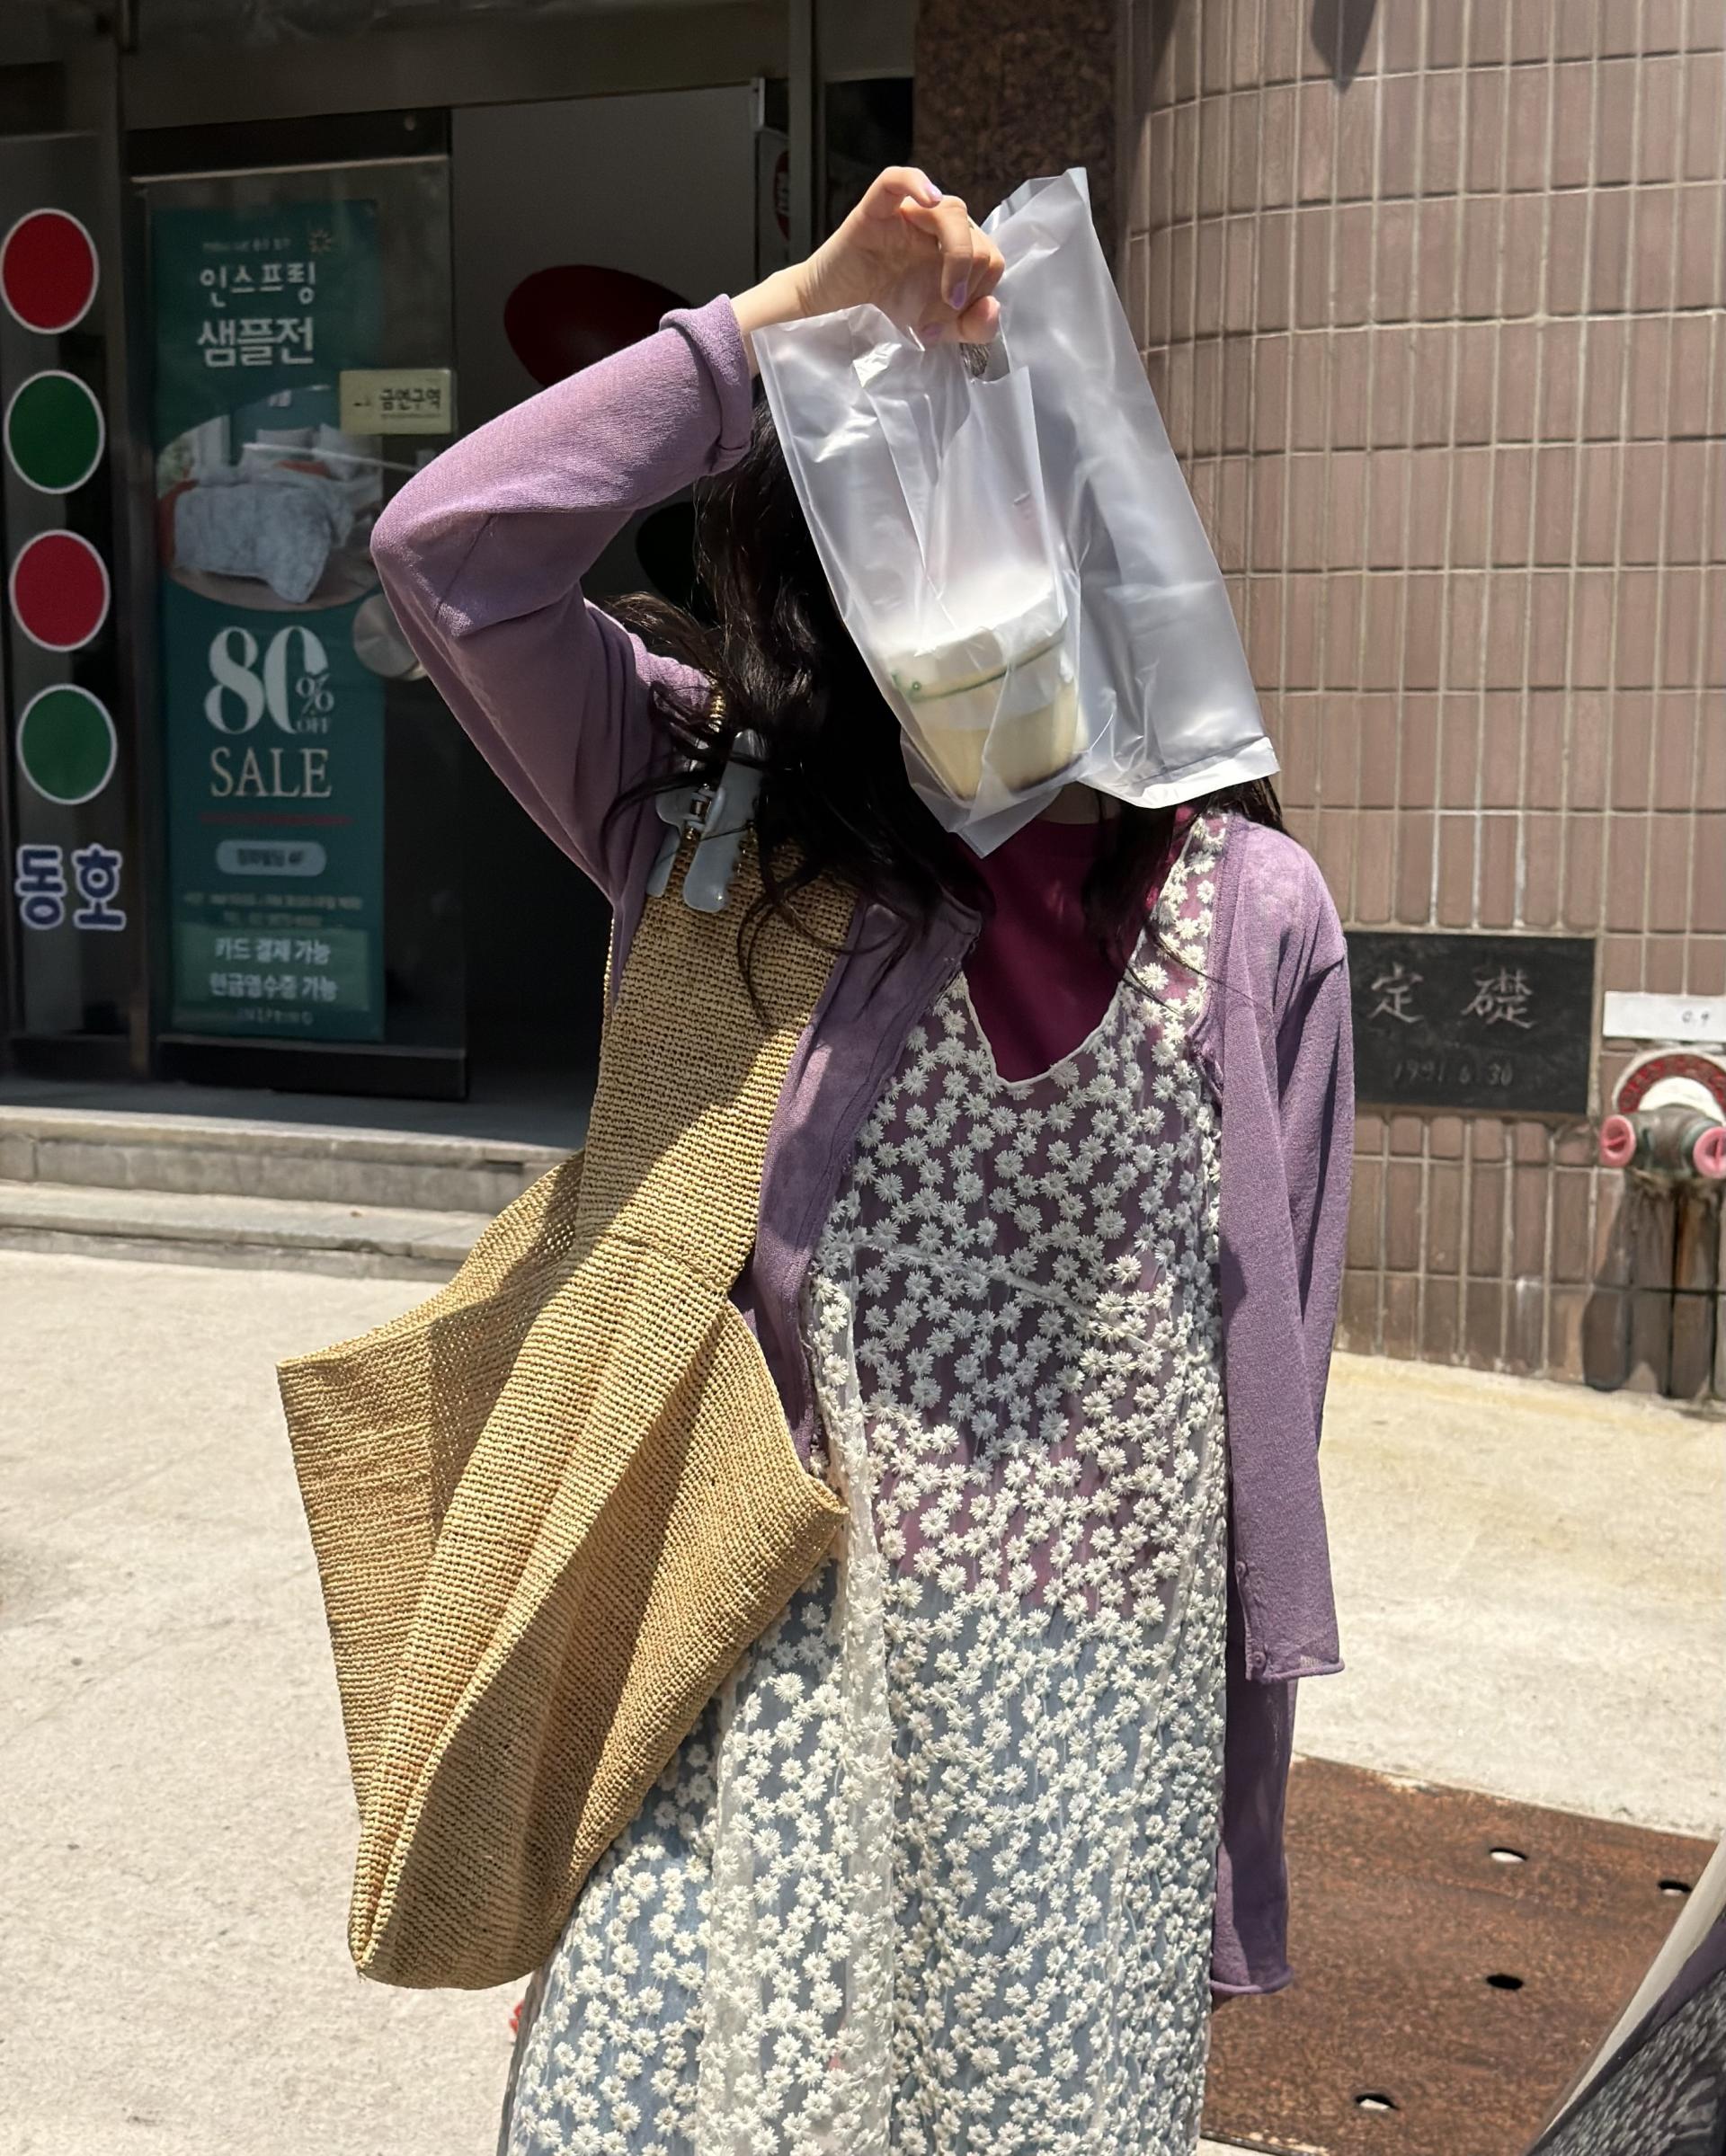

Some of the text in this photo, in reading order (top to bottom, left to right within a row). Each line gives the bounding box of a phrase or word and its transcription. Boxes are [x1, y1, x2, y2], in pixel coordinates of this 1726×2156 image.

[199, 262, 316, 307] 인스프링
[197, 316, 316, 368] 샘플전
[379, 387, 441, 411] 금연구역
[209, 747, 333, 798] SALE
[215, 936, 332, 965] 카드 결제 가능
[209, 972, 338, 1002] 현금영수증 가능
[1366, 960, 1538, 1030] 定礎
